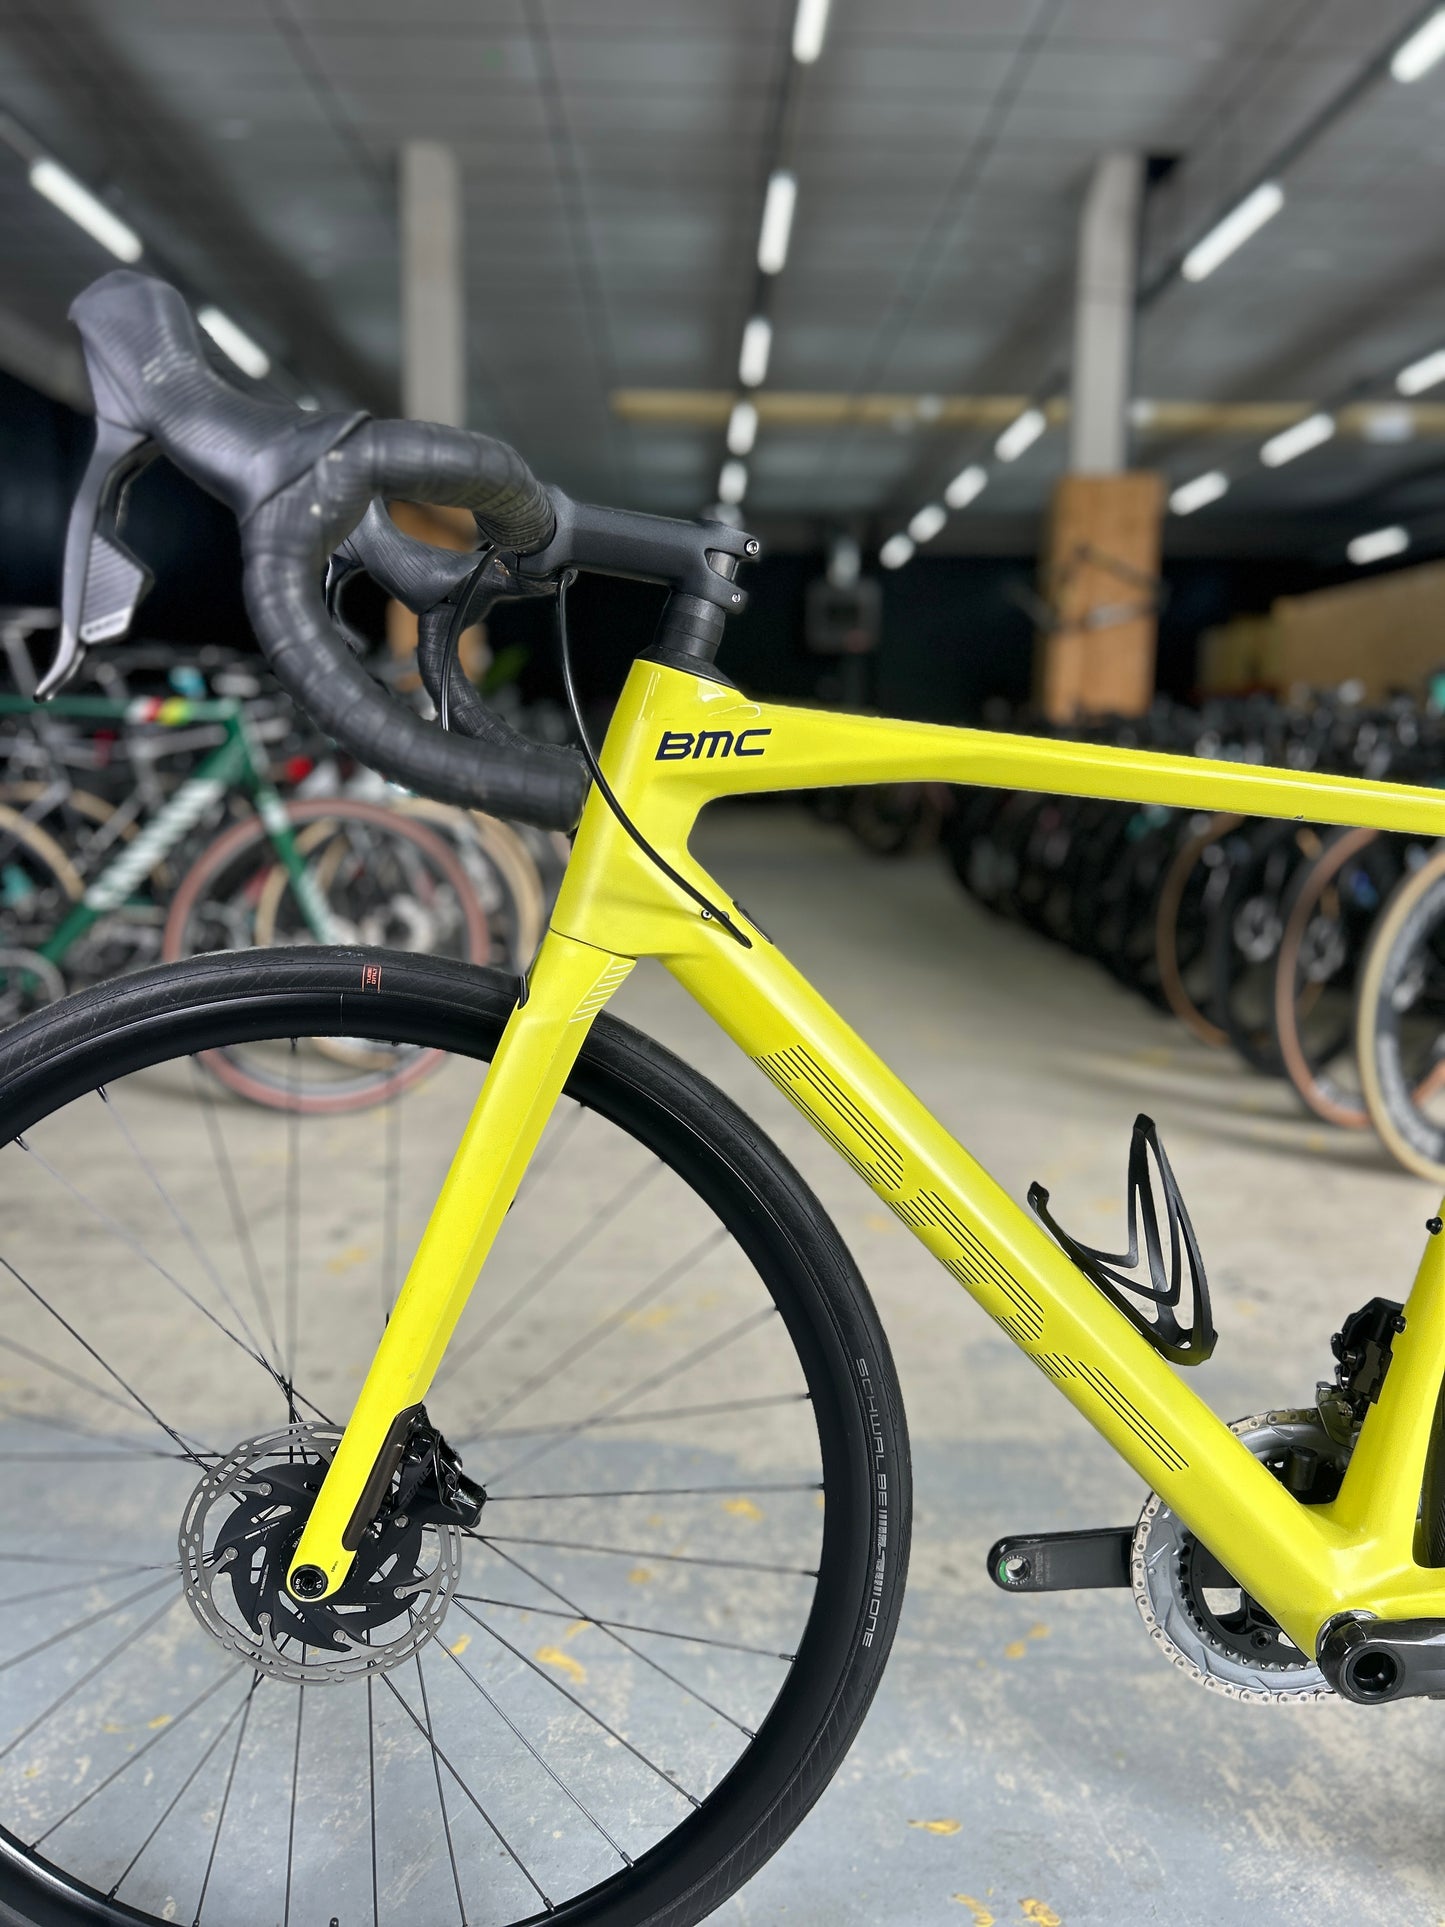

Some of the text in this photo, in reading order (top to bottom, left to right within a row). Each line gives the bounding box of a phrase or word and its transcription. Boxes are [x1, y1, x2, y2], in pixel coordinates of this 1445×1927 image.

[655, 728, 772, 760] BMC
[855, 1358, 888, 1648] SCHWALBE ONE
